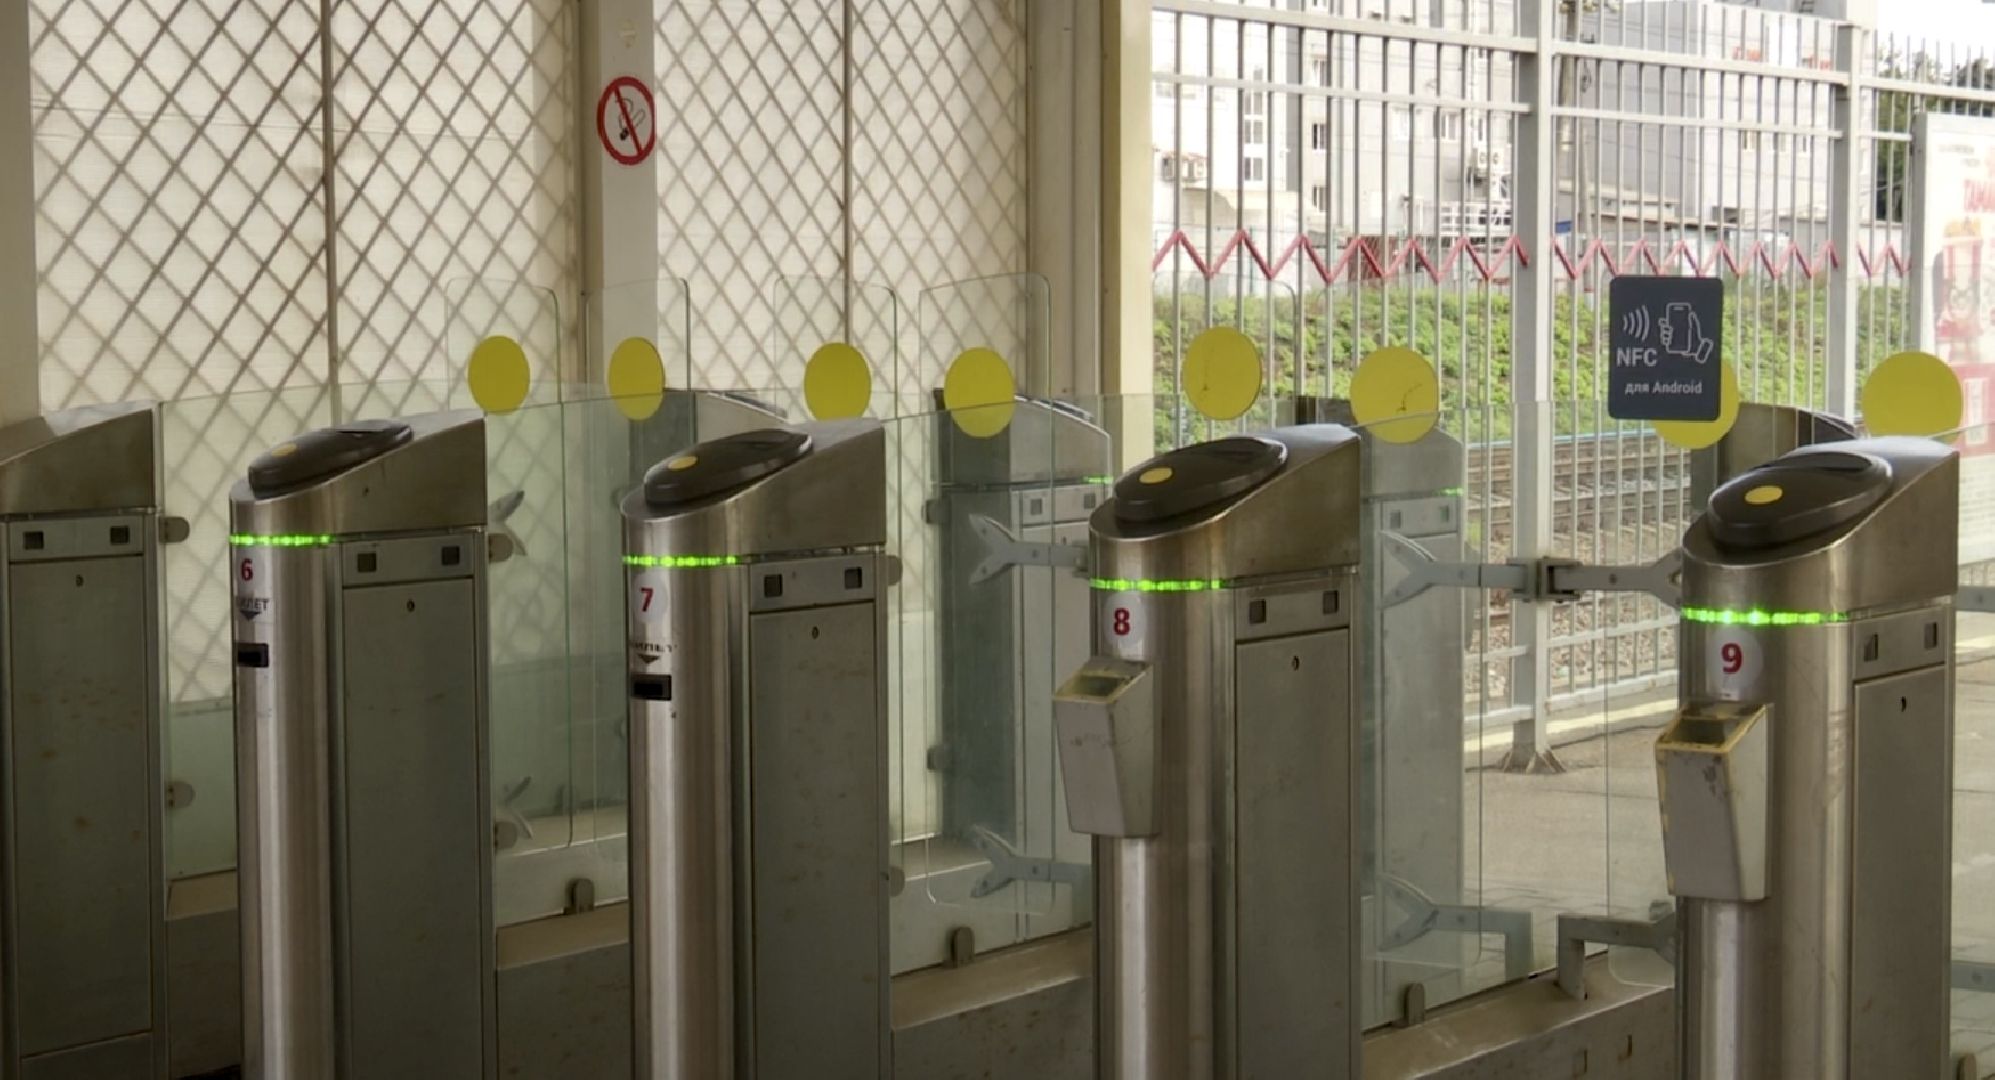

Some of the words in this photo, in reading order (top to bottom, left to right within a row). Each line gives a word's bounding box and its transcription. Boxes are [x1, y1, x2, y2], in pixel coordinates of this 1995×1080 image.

[1616, 347, 1658, 367] NFC
[1624, 383, 1650, 395] для
[1652, 381, 1703, 394] Android
[241, 558, 253, 582] 6
[640, 587, 653, 612] 7
[1113, 607, 1130, 636] 8
[1721, 643, 1743, 674] 9
